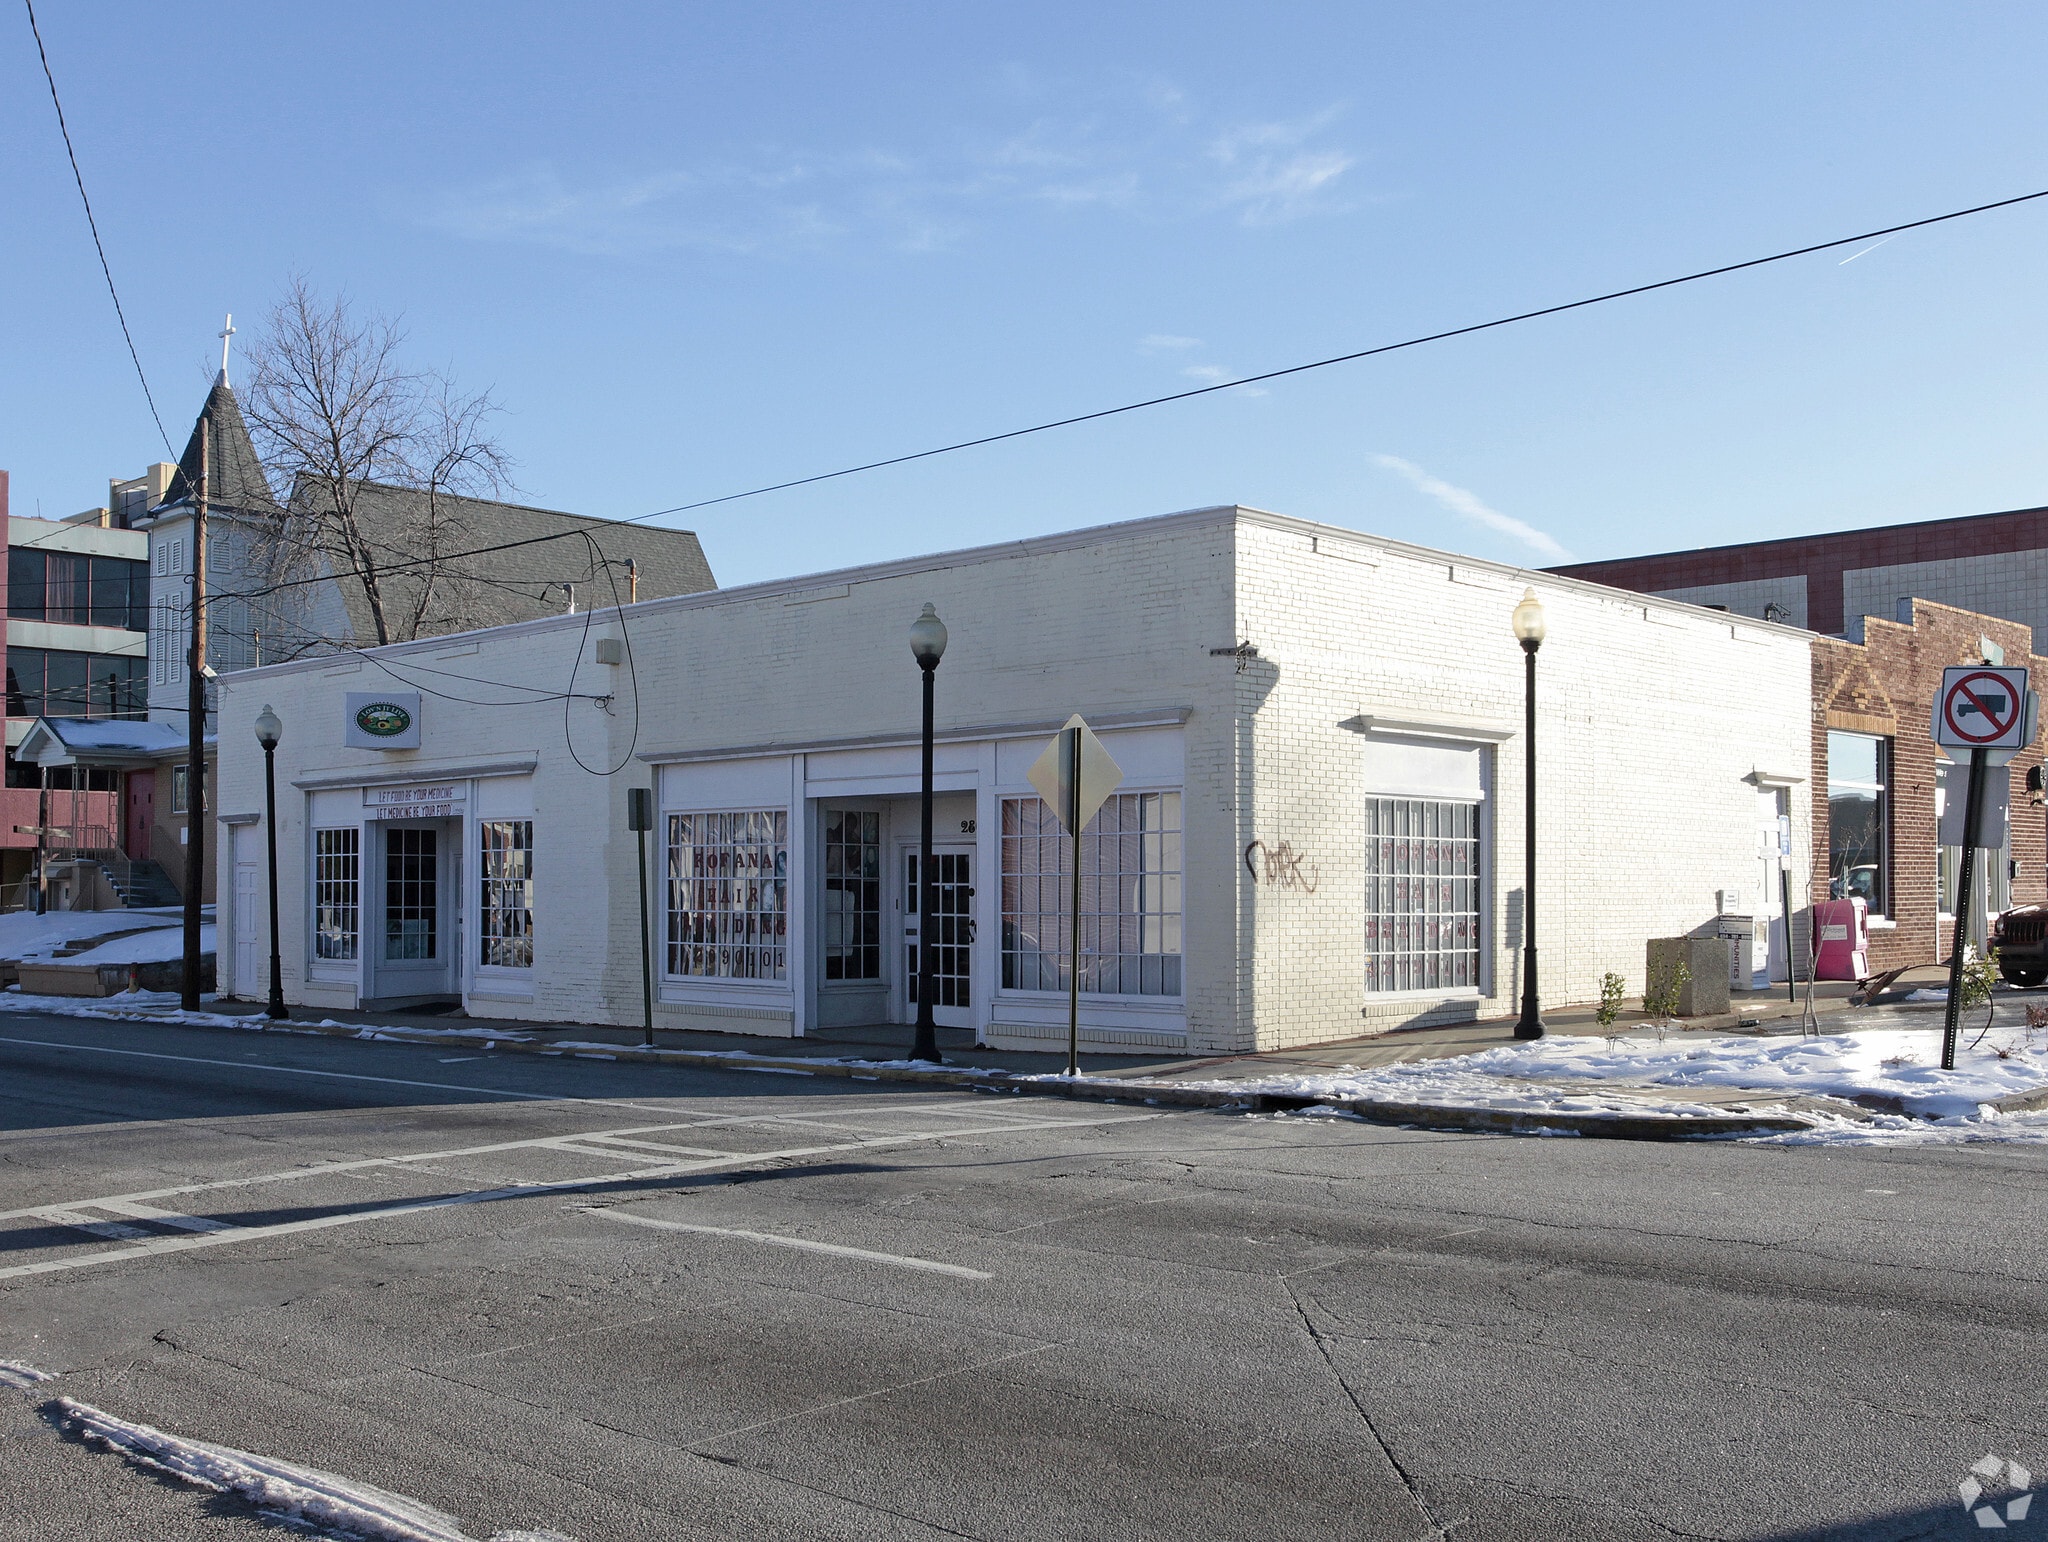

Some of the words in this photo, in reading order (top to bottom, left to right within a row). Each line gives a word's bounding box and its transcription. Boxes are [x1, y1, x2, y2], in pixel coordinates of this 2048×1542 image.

[378, 791, 390, 802] LET
[391, 790, 405, 802] FOOD
[405, 789, 412, 801] BE
[413, 788, 427, 800] YOUR
[428, 787, 453, 799] MEDICINE
[376, 807, 387, 820] LET
[388, 806, 412, 819] MEDICINE
[413, 806, 420, 817] BE
[421, 805, 436, 817] YOUR
[693, 852, 773, 869] FOFANA
[1381, 843, 1467, 862] FOFANA
[707, 887, 758, 903] HAIR
[1397, 882, 1451, 902] HAIR
